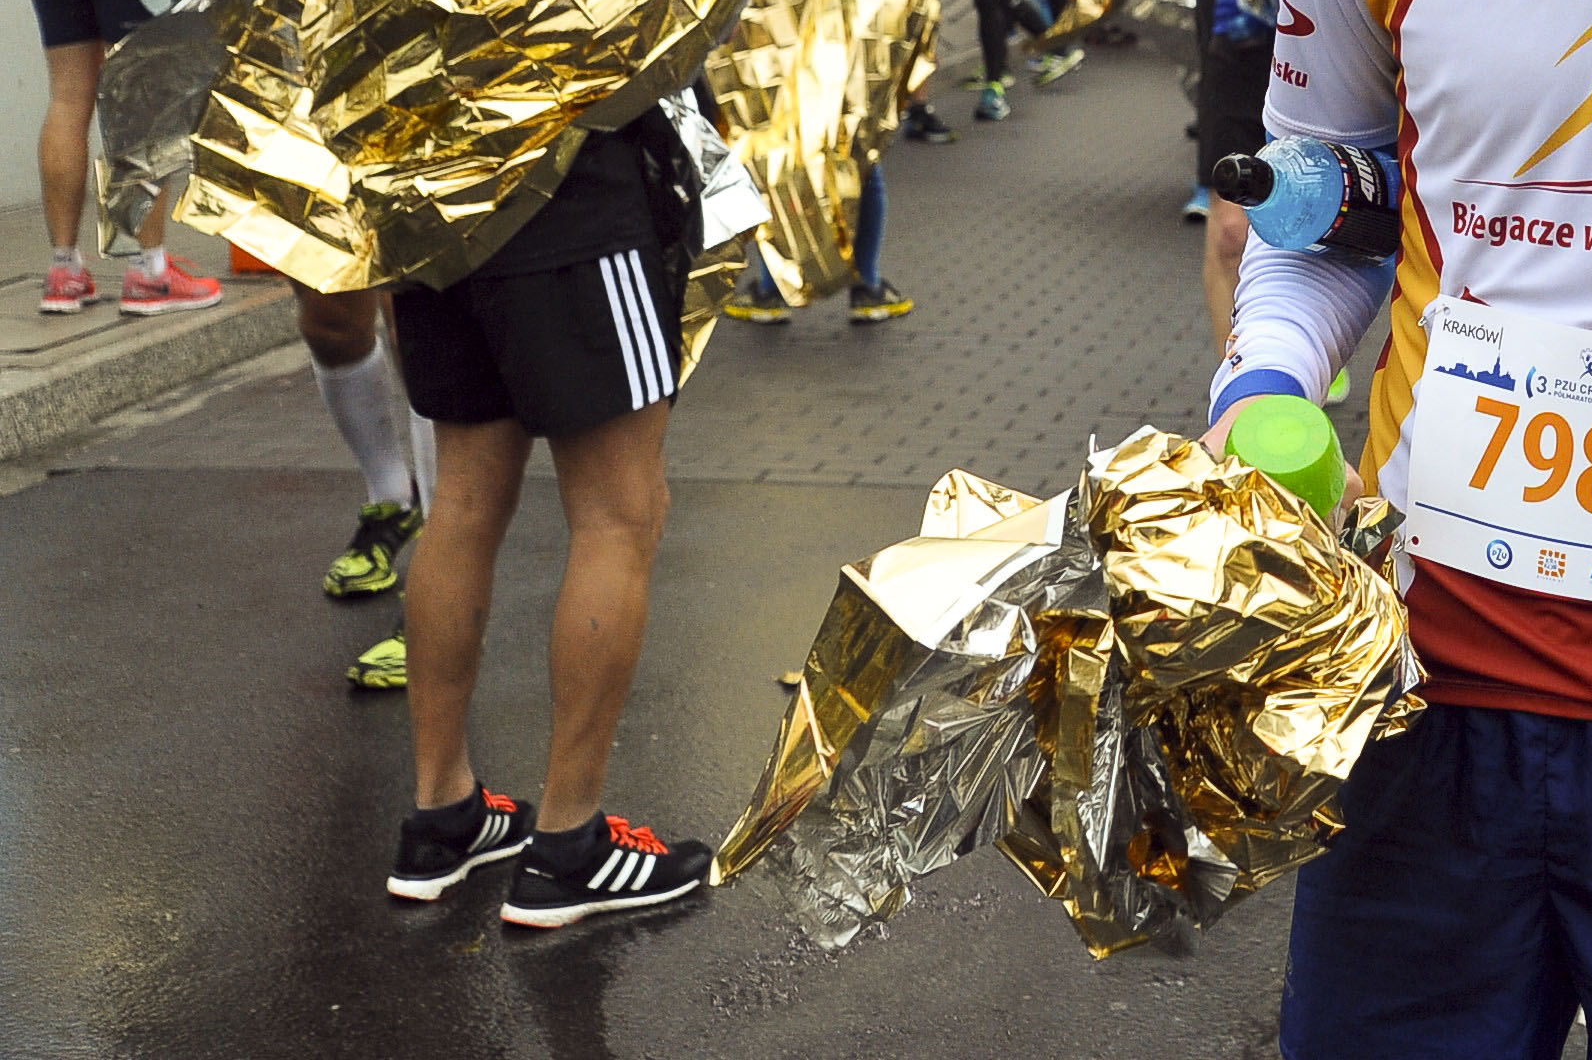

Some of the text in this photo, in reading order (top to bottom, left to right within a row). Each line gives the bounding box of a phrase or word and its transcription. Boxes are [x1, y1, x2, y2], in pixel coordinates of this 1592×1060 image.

[1451, 201, 1574, 249] Biegacze
[1442, 317, 1500, 344] KRAKÓW
[1554, 378, 1577, 393] PZU
[1491, 547, 1508, 562] PZU
